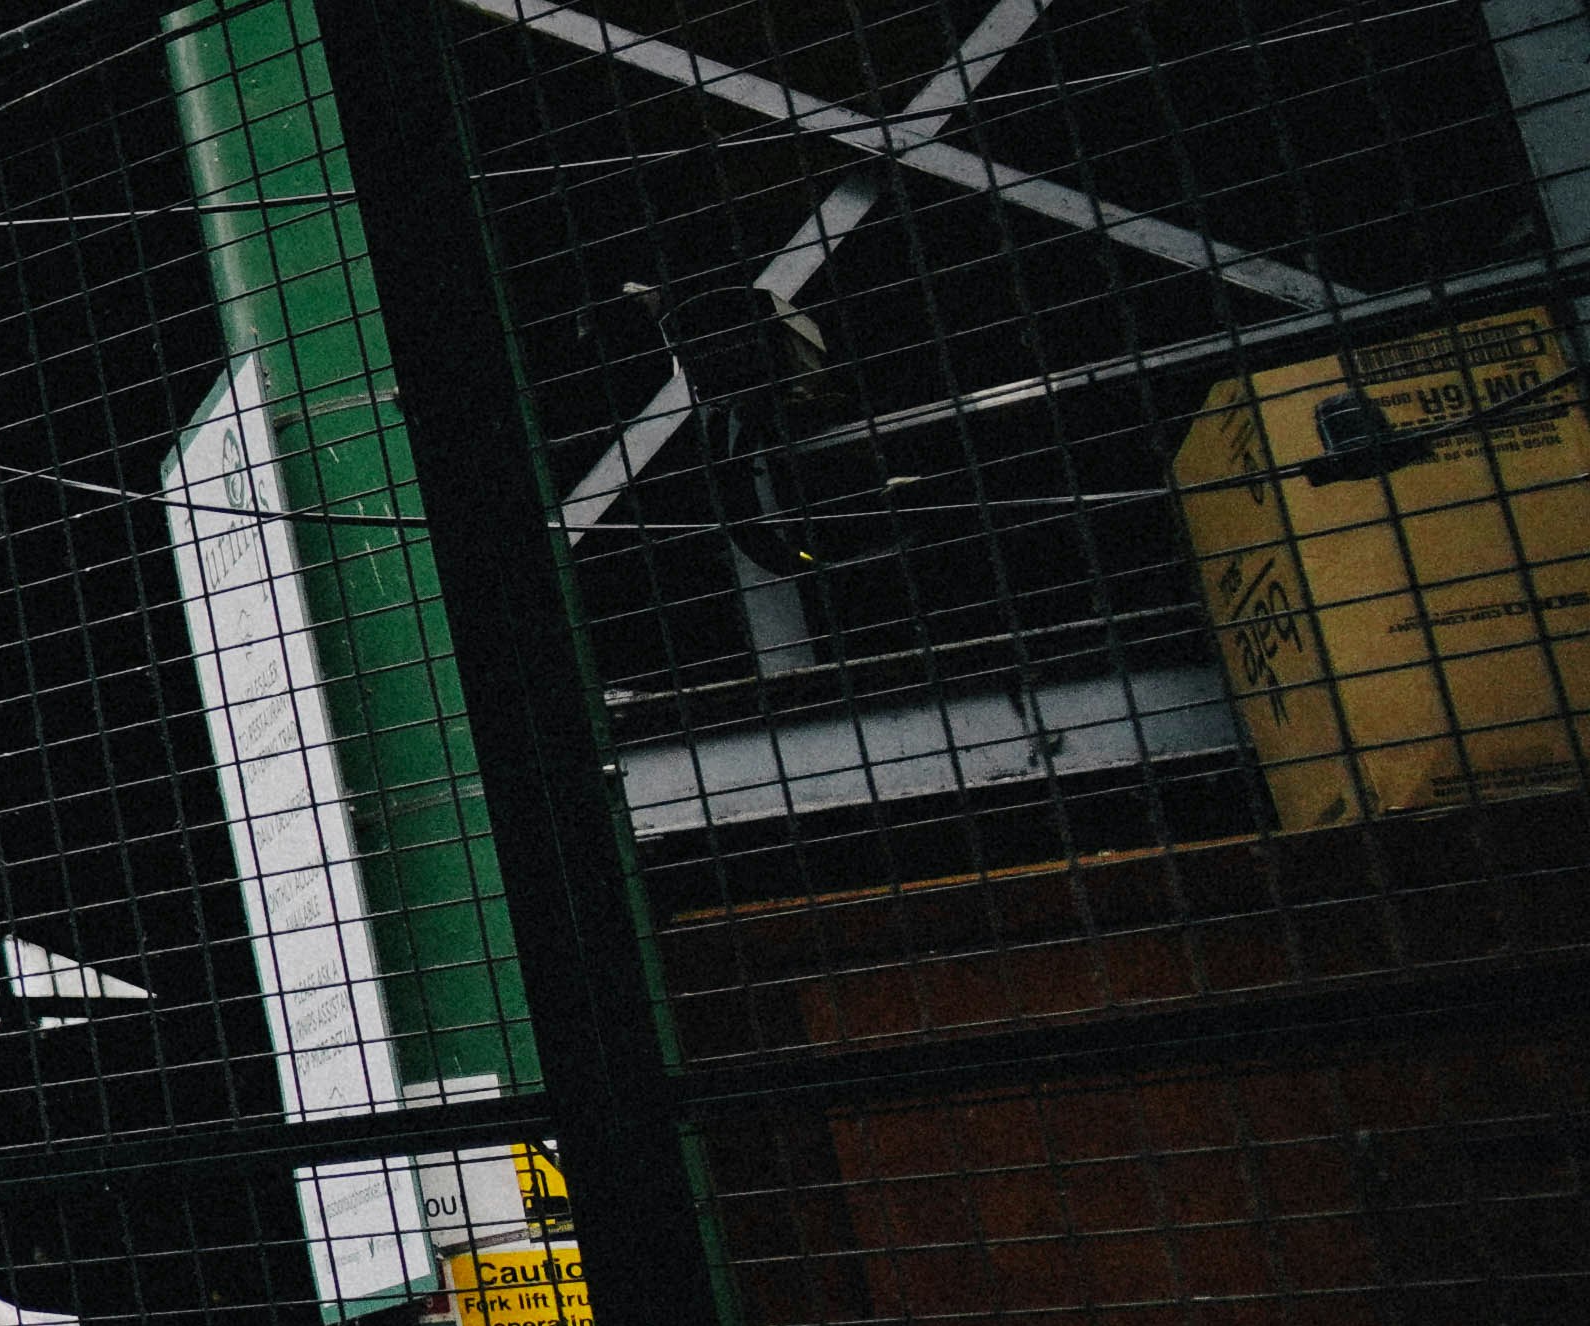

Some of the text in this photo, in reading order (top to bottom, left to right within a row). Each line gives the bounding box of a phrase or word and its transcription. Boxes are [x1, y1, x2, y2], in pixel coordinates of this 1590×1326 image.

[476, 1258, 584, 1287] Cautio
[465, 1293, 513, 1314] Fork
[517, 1291, 550, 1310] lift
